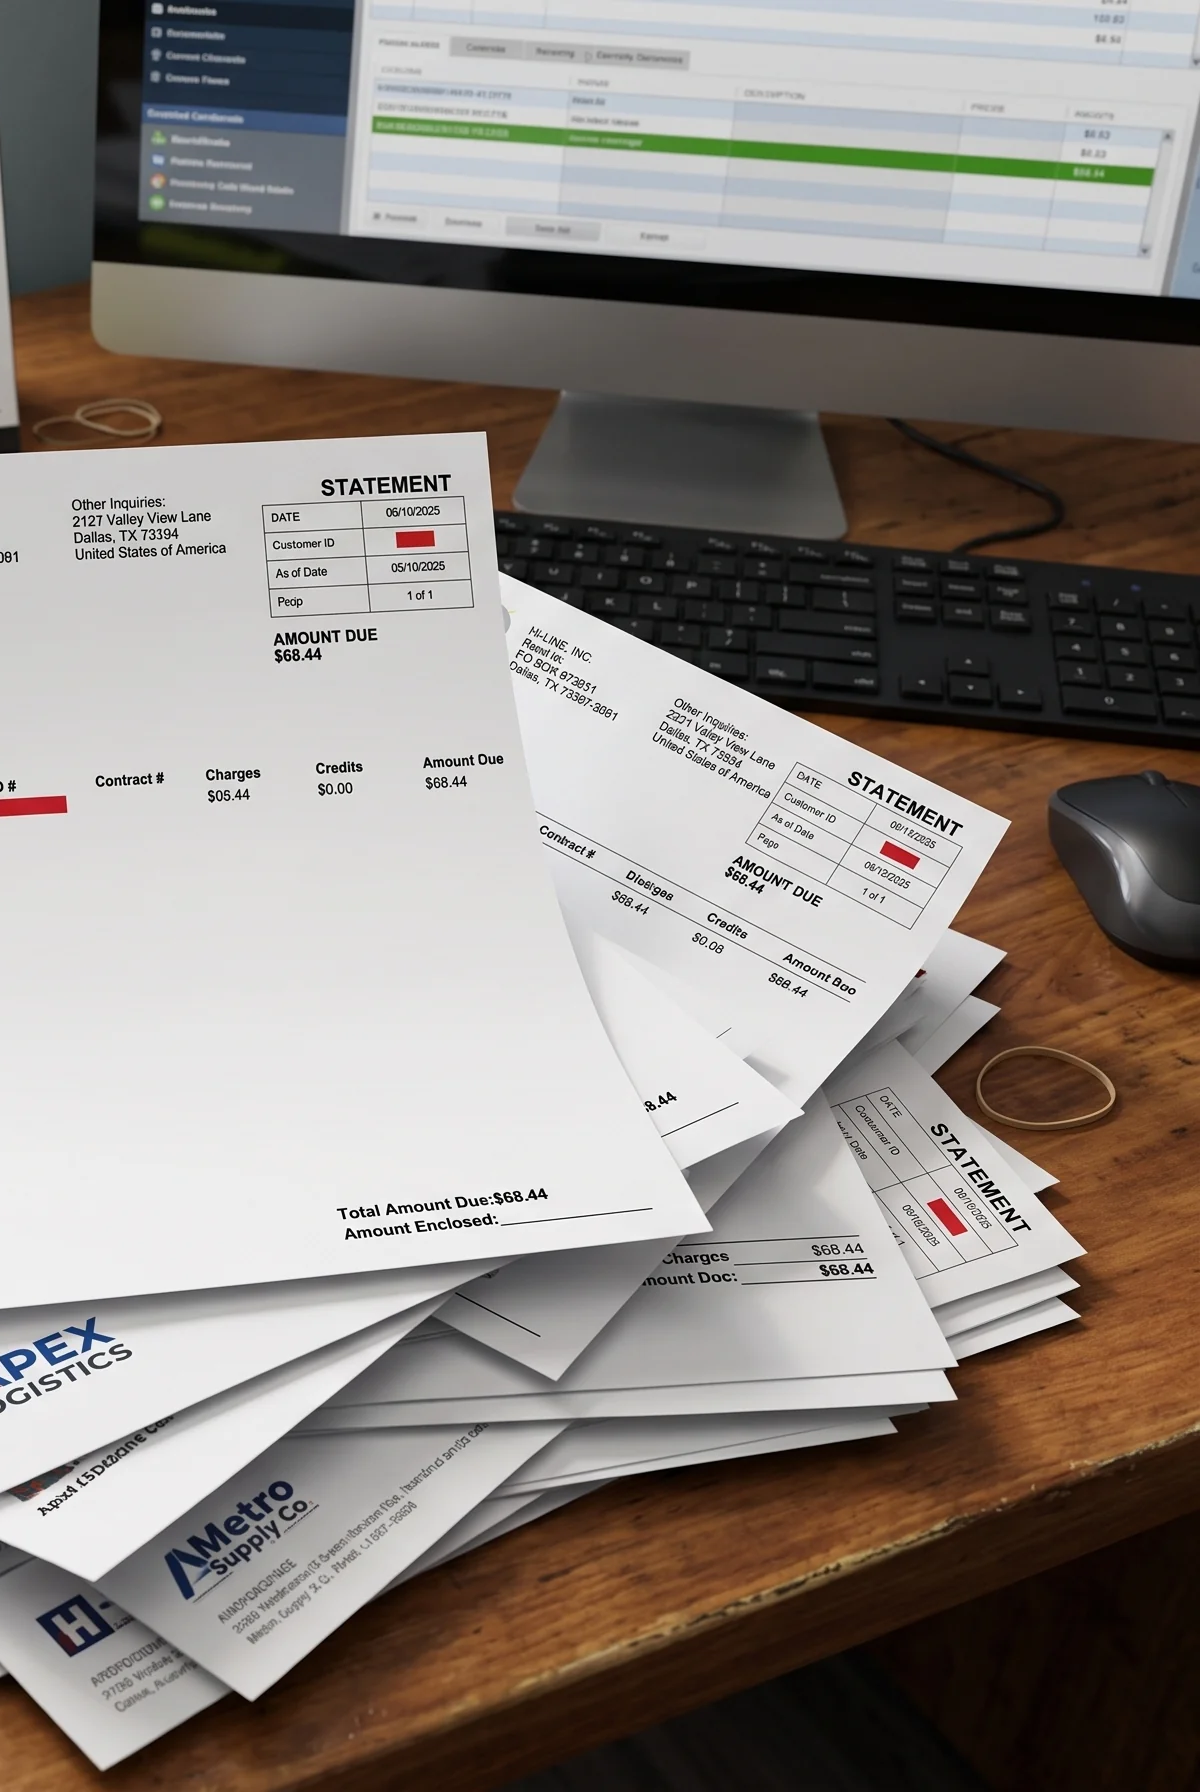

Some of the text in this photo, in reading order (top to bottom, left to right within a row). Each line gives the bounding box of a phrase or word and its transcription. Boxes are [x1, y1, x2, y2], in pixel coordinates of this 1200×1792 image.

[321, 473, 451, 497] STATEMENT
[71, 496, 166, 511] Other Inquiries:
[385, 505, 440, 517] 06/10/2025
[72, 510, 211, 527] 2127 Valley View Lane
[271, 511, 300, 523] DATE
[73, 527, 179, 544] Dallas, TX 73394
[272, 537, 335, 550] Customer ID
[75, 543, 226, 560] United States of America
[275, 566, 328, 578] As of Date
[391, 560, 446, 573] 05/10/2025
[273, 627, 378, 646] AMOUNT DUE
[274, 647, 322, 664] $68.44
[315, 761, 363, 774] Credits
[422, 753, 504, 768] Amount Due
[95, 773, 153, 787] Contract
[205, 768, 261, 782] Charges
[425, 775, 467, 790] $68.44
[796, 771, 823, 789] DATE
[317, 781, 353, 796] $0.00
[847, 771, 964, 836] STATEMENT
[792, 885, 823, 907] DUE
[782, 953, 831, 983] Amount
[931, 1124, 1031, 1232] STATEMENT
[336, 1204, 381, 1220] Total
[385, 1198, 452, 1216] Amount
[344, 1212, 504, 1240] Amount Enclosed:
[819, 1263, 874, 1276] $68.44
[209, 1520, 281, 1575] Supply
